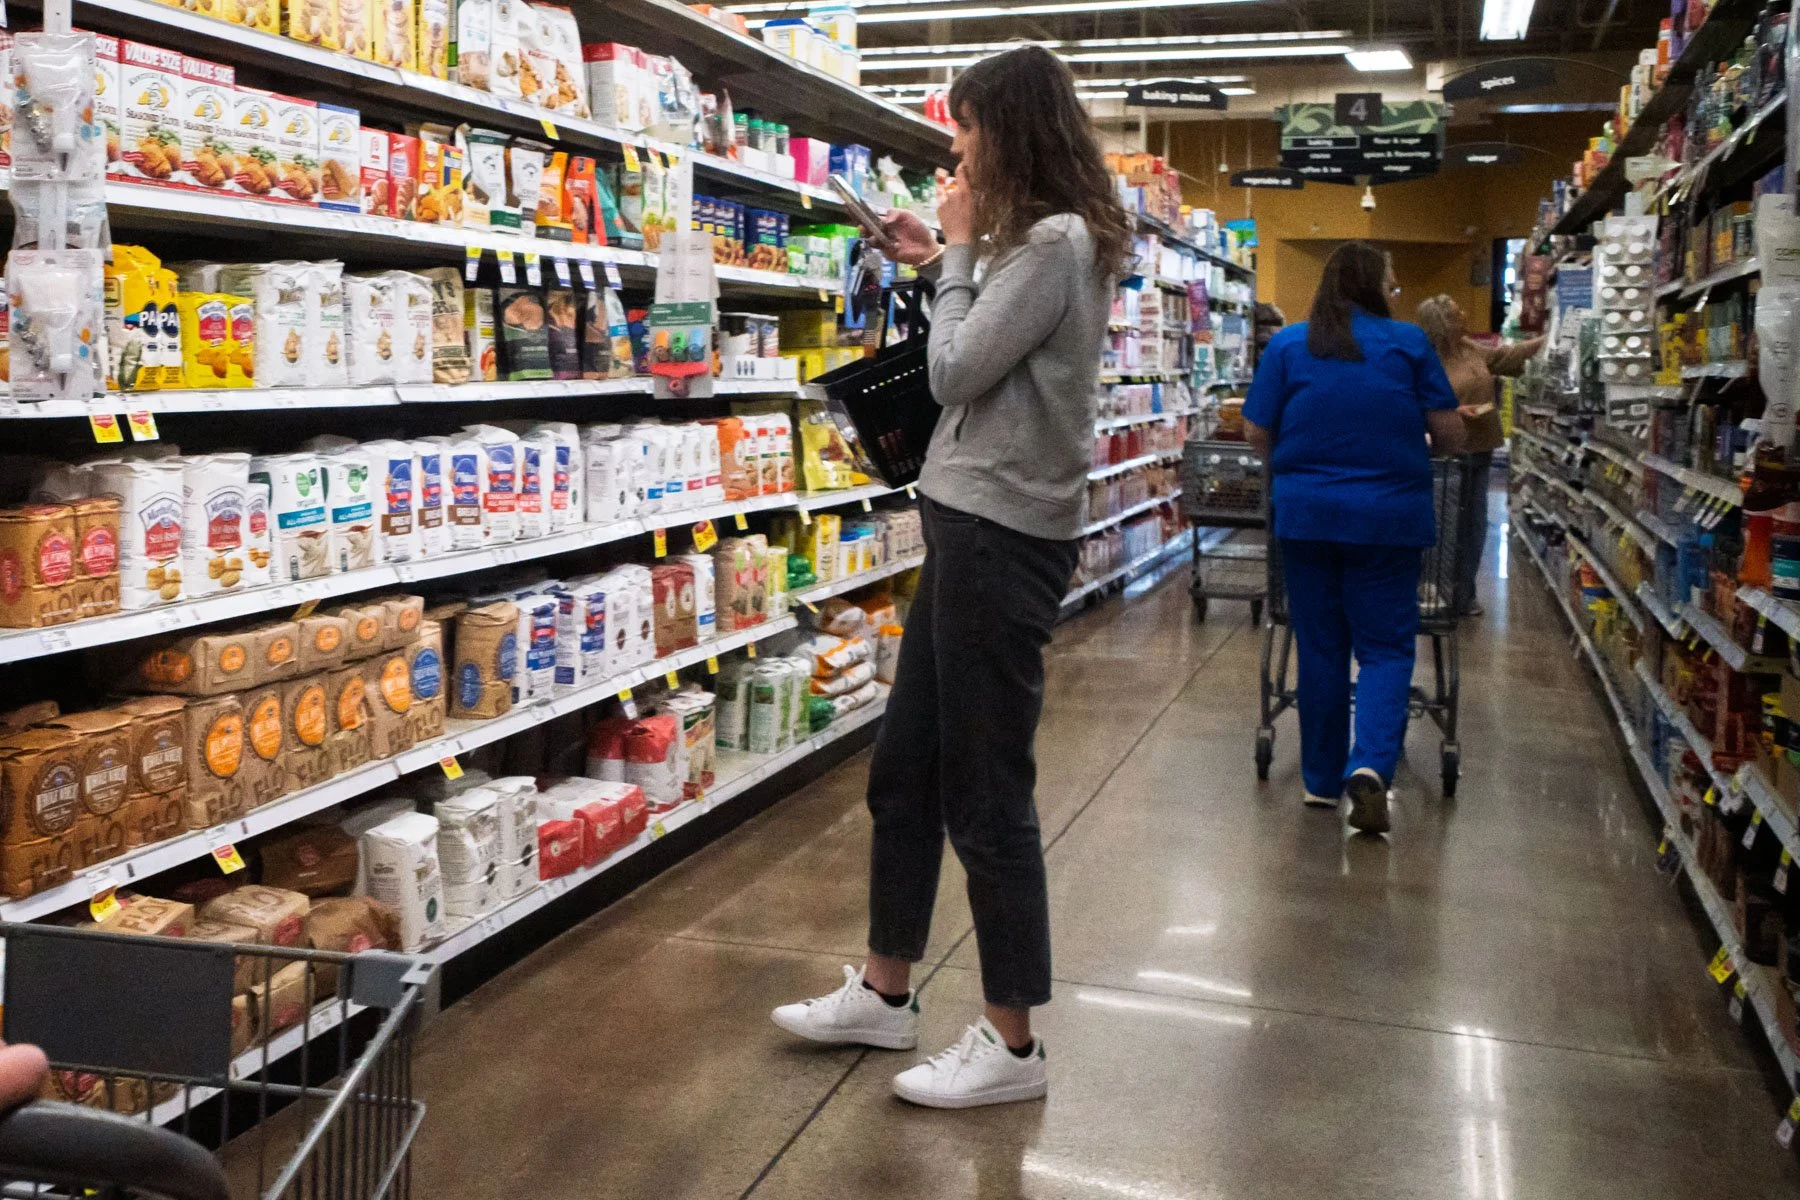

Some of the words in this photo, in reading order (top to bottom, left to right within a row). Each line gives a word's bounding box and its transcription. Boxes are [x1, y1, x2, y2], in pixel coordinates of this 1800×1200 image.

[126, 43, 159, 65] VALUE
[160, 52, 181, 71] SIZE
[183, 59, 214, 79] VALUE
[215, 66, 234, 84] SIZE
[1481, 76, 1515, 90] spices
[1142, 90, 1178, 103] baking
[1180, 92, 1211, 102] mixes
[1349, 99, 1367, 121] 4
